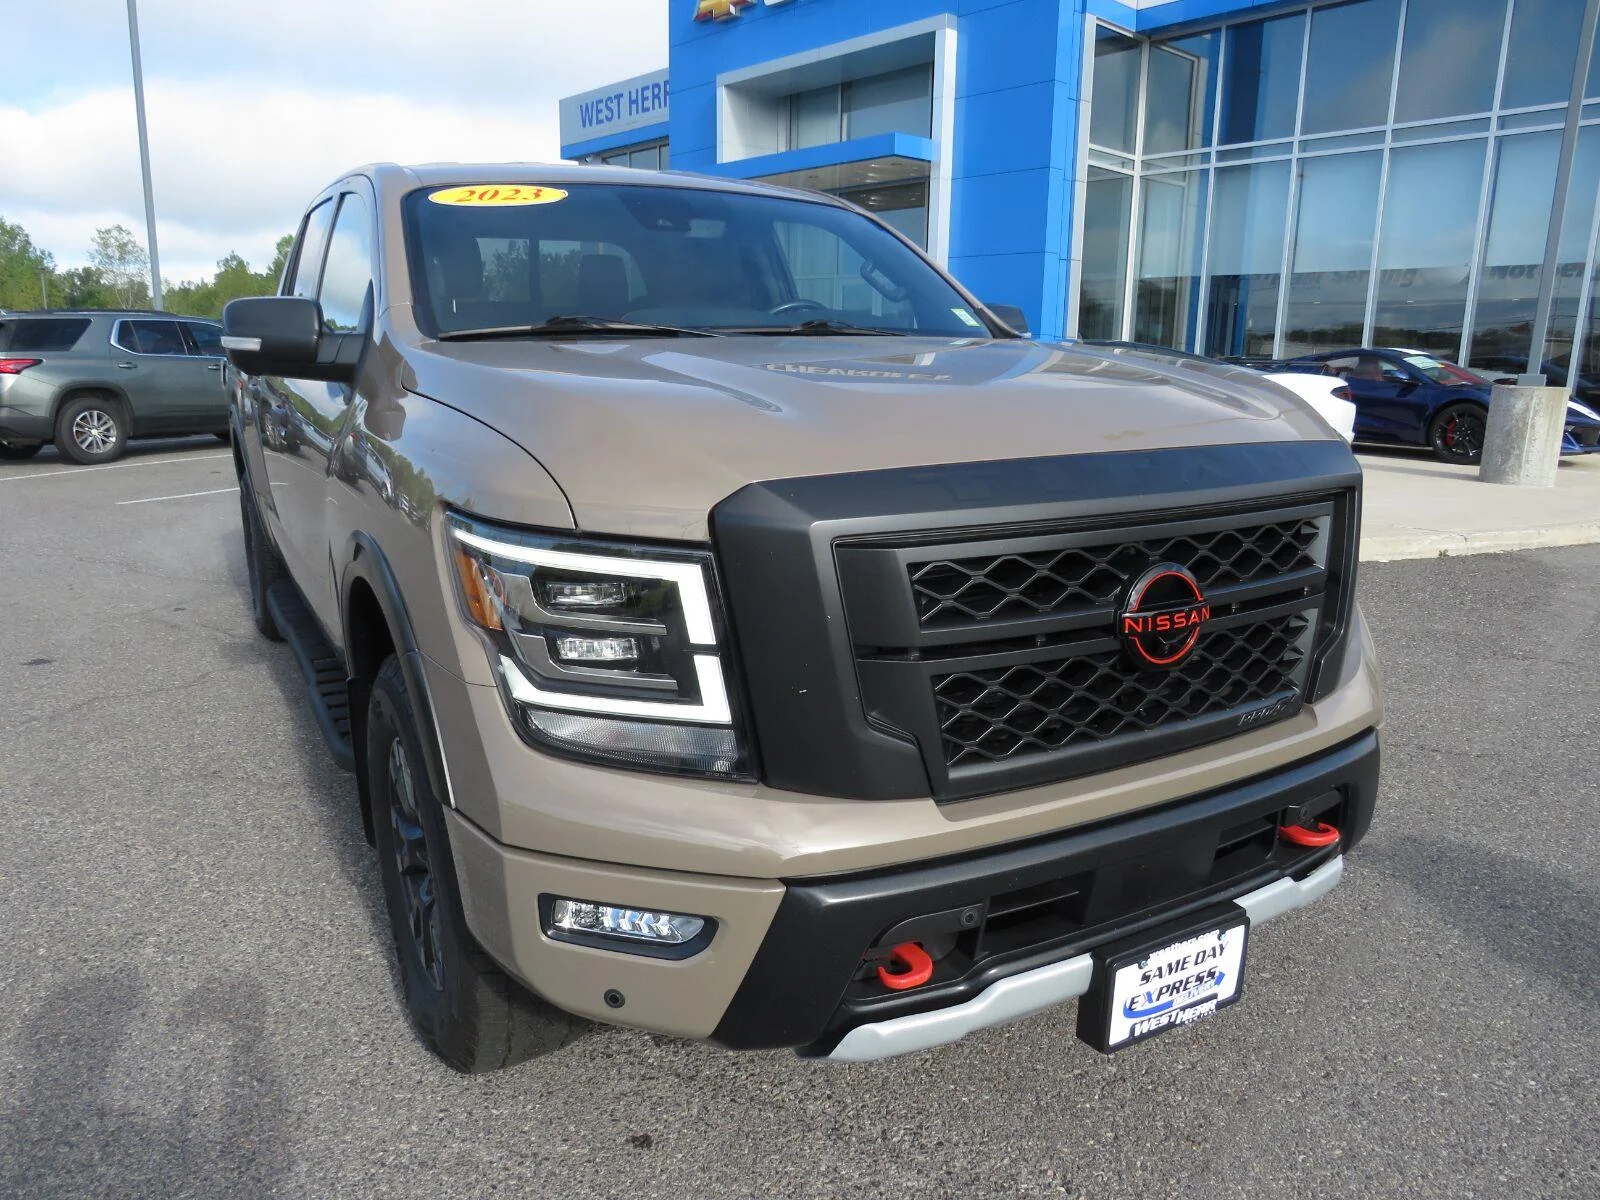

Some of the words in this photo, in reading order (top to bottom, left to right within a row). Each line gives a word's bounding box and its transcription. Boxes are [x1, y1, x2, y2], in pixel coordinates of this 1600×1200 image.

[579, 92, 624, 128] WEST
[454, 188, 543, 203] 2023
[1123, 604, 1210, 634] NISSAN
[1139, 955, 1192, 986] SAME
[1193, 941, 1229, 966] DAY
[1127, 965, 1219, 1012] EXPRESS
